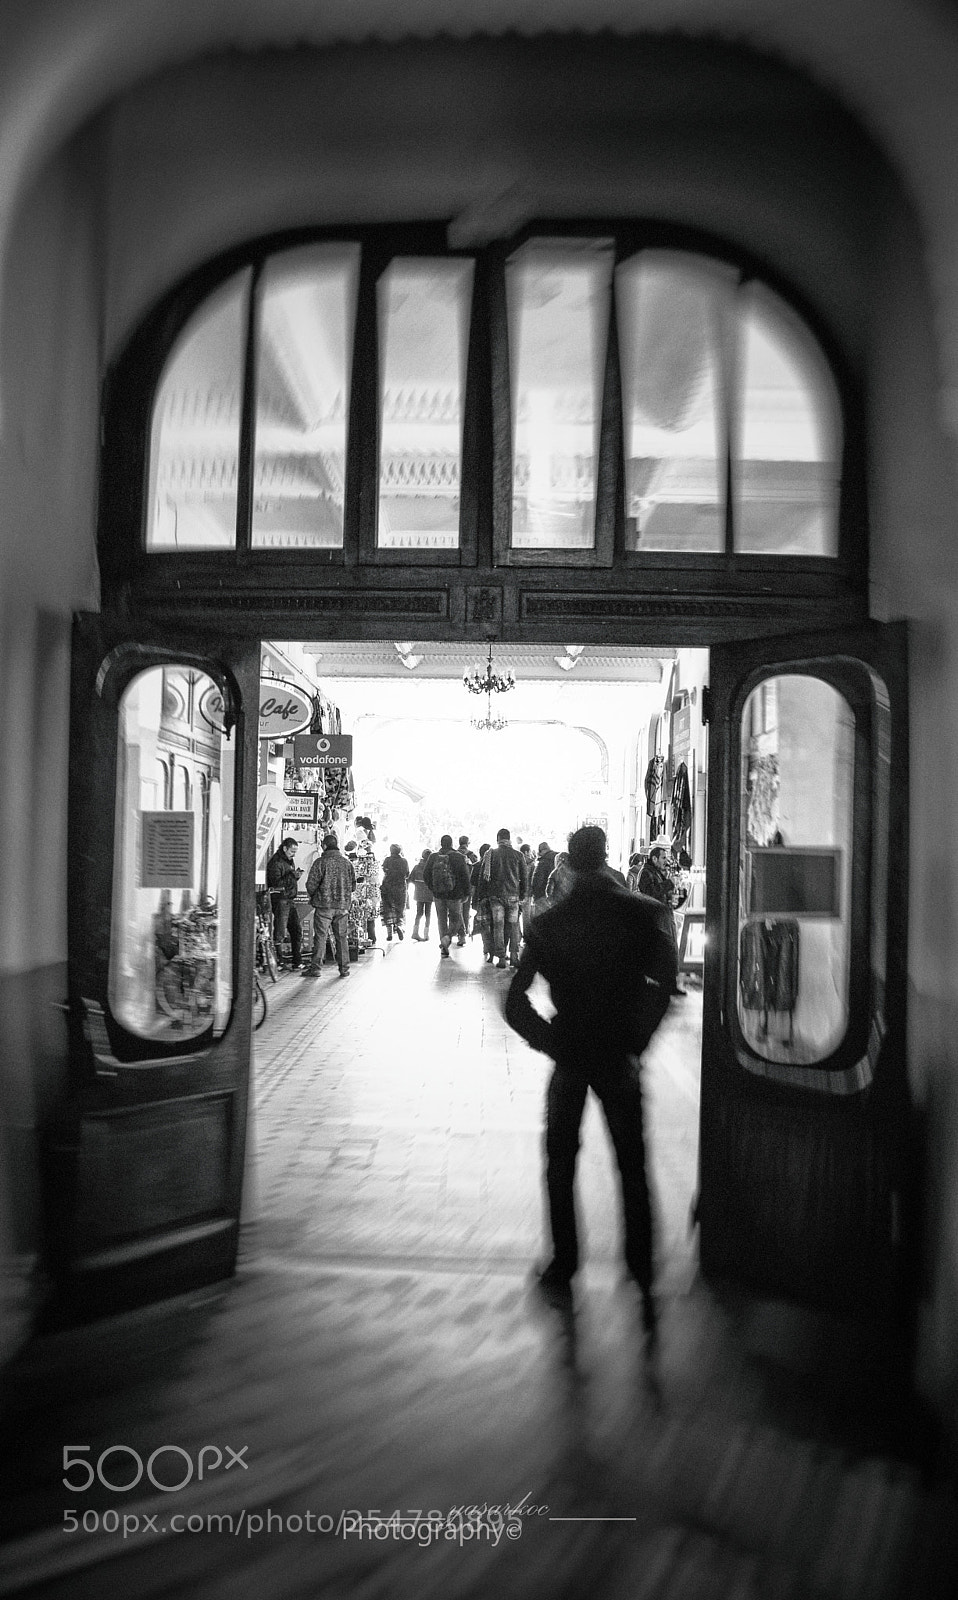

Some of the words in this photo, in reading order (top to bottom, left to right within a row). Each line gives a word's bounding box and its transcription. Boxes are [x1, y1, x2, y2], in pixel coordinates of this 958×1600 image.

[260, 698, 299, 720] Cafe
[300, 755, 348, 764] vodafone
[256, 802, 278, 849] NET
